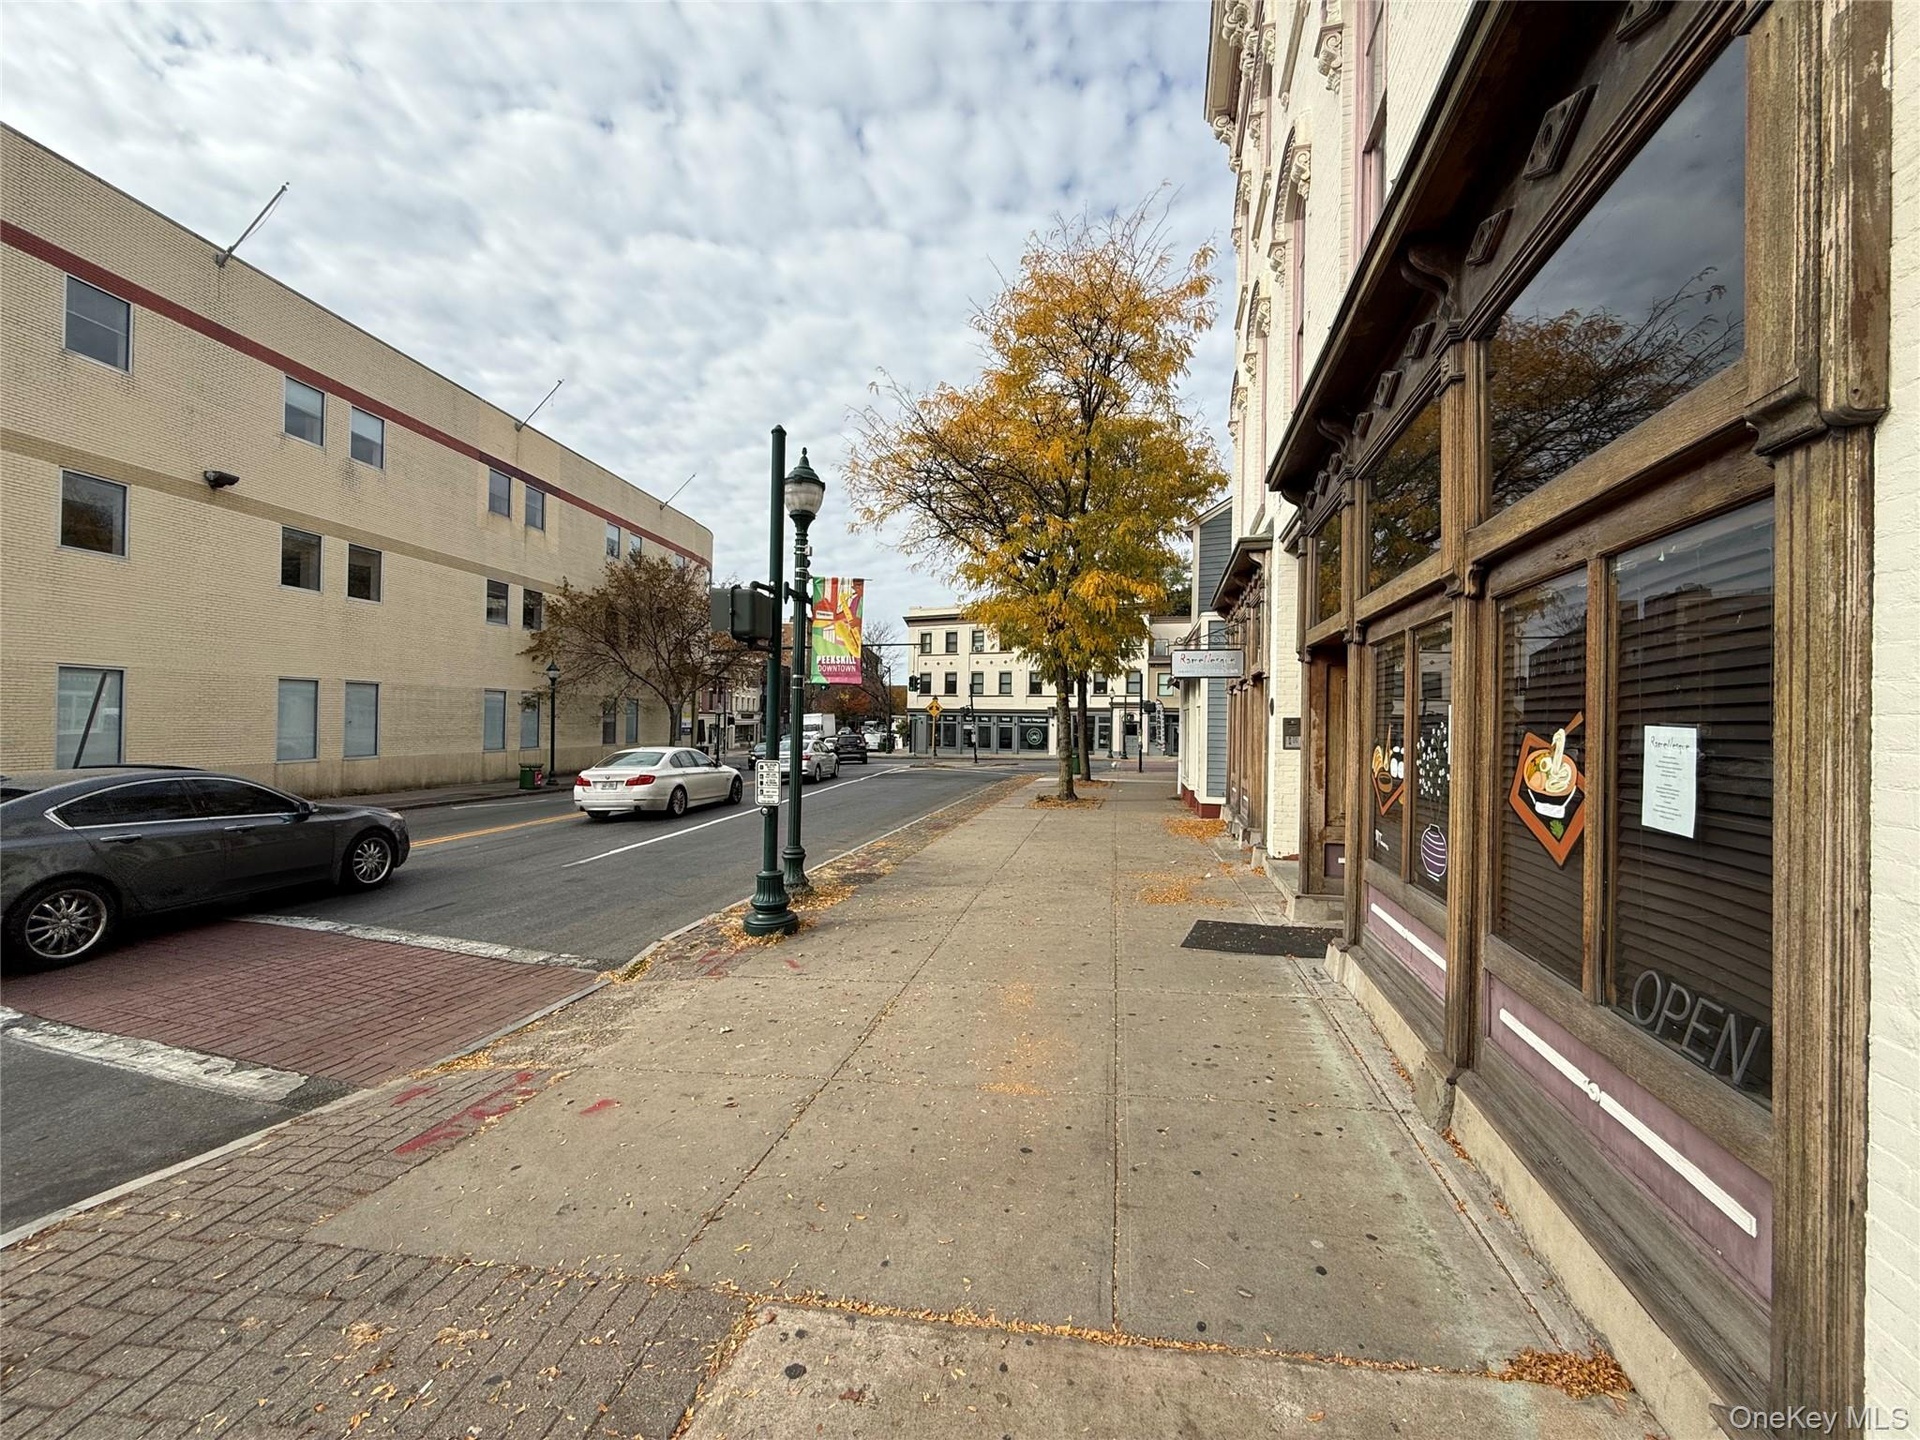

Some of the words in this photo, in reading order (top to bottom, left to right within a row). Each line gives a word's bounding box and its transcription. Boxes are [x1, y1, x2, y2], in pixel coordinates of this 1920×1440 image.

[816, 655, 857, 665] PEEKSKILL
[817, 664, 857, 673] DOWNTOWN
[1632, 969, 1762, 1085] OPEN
